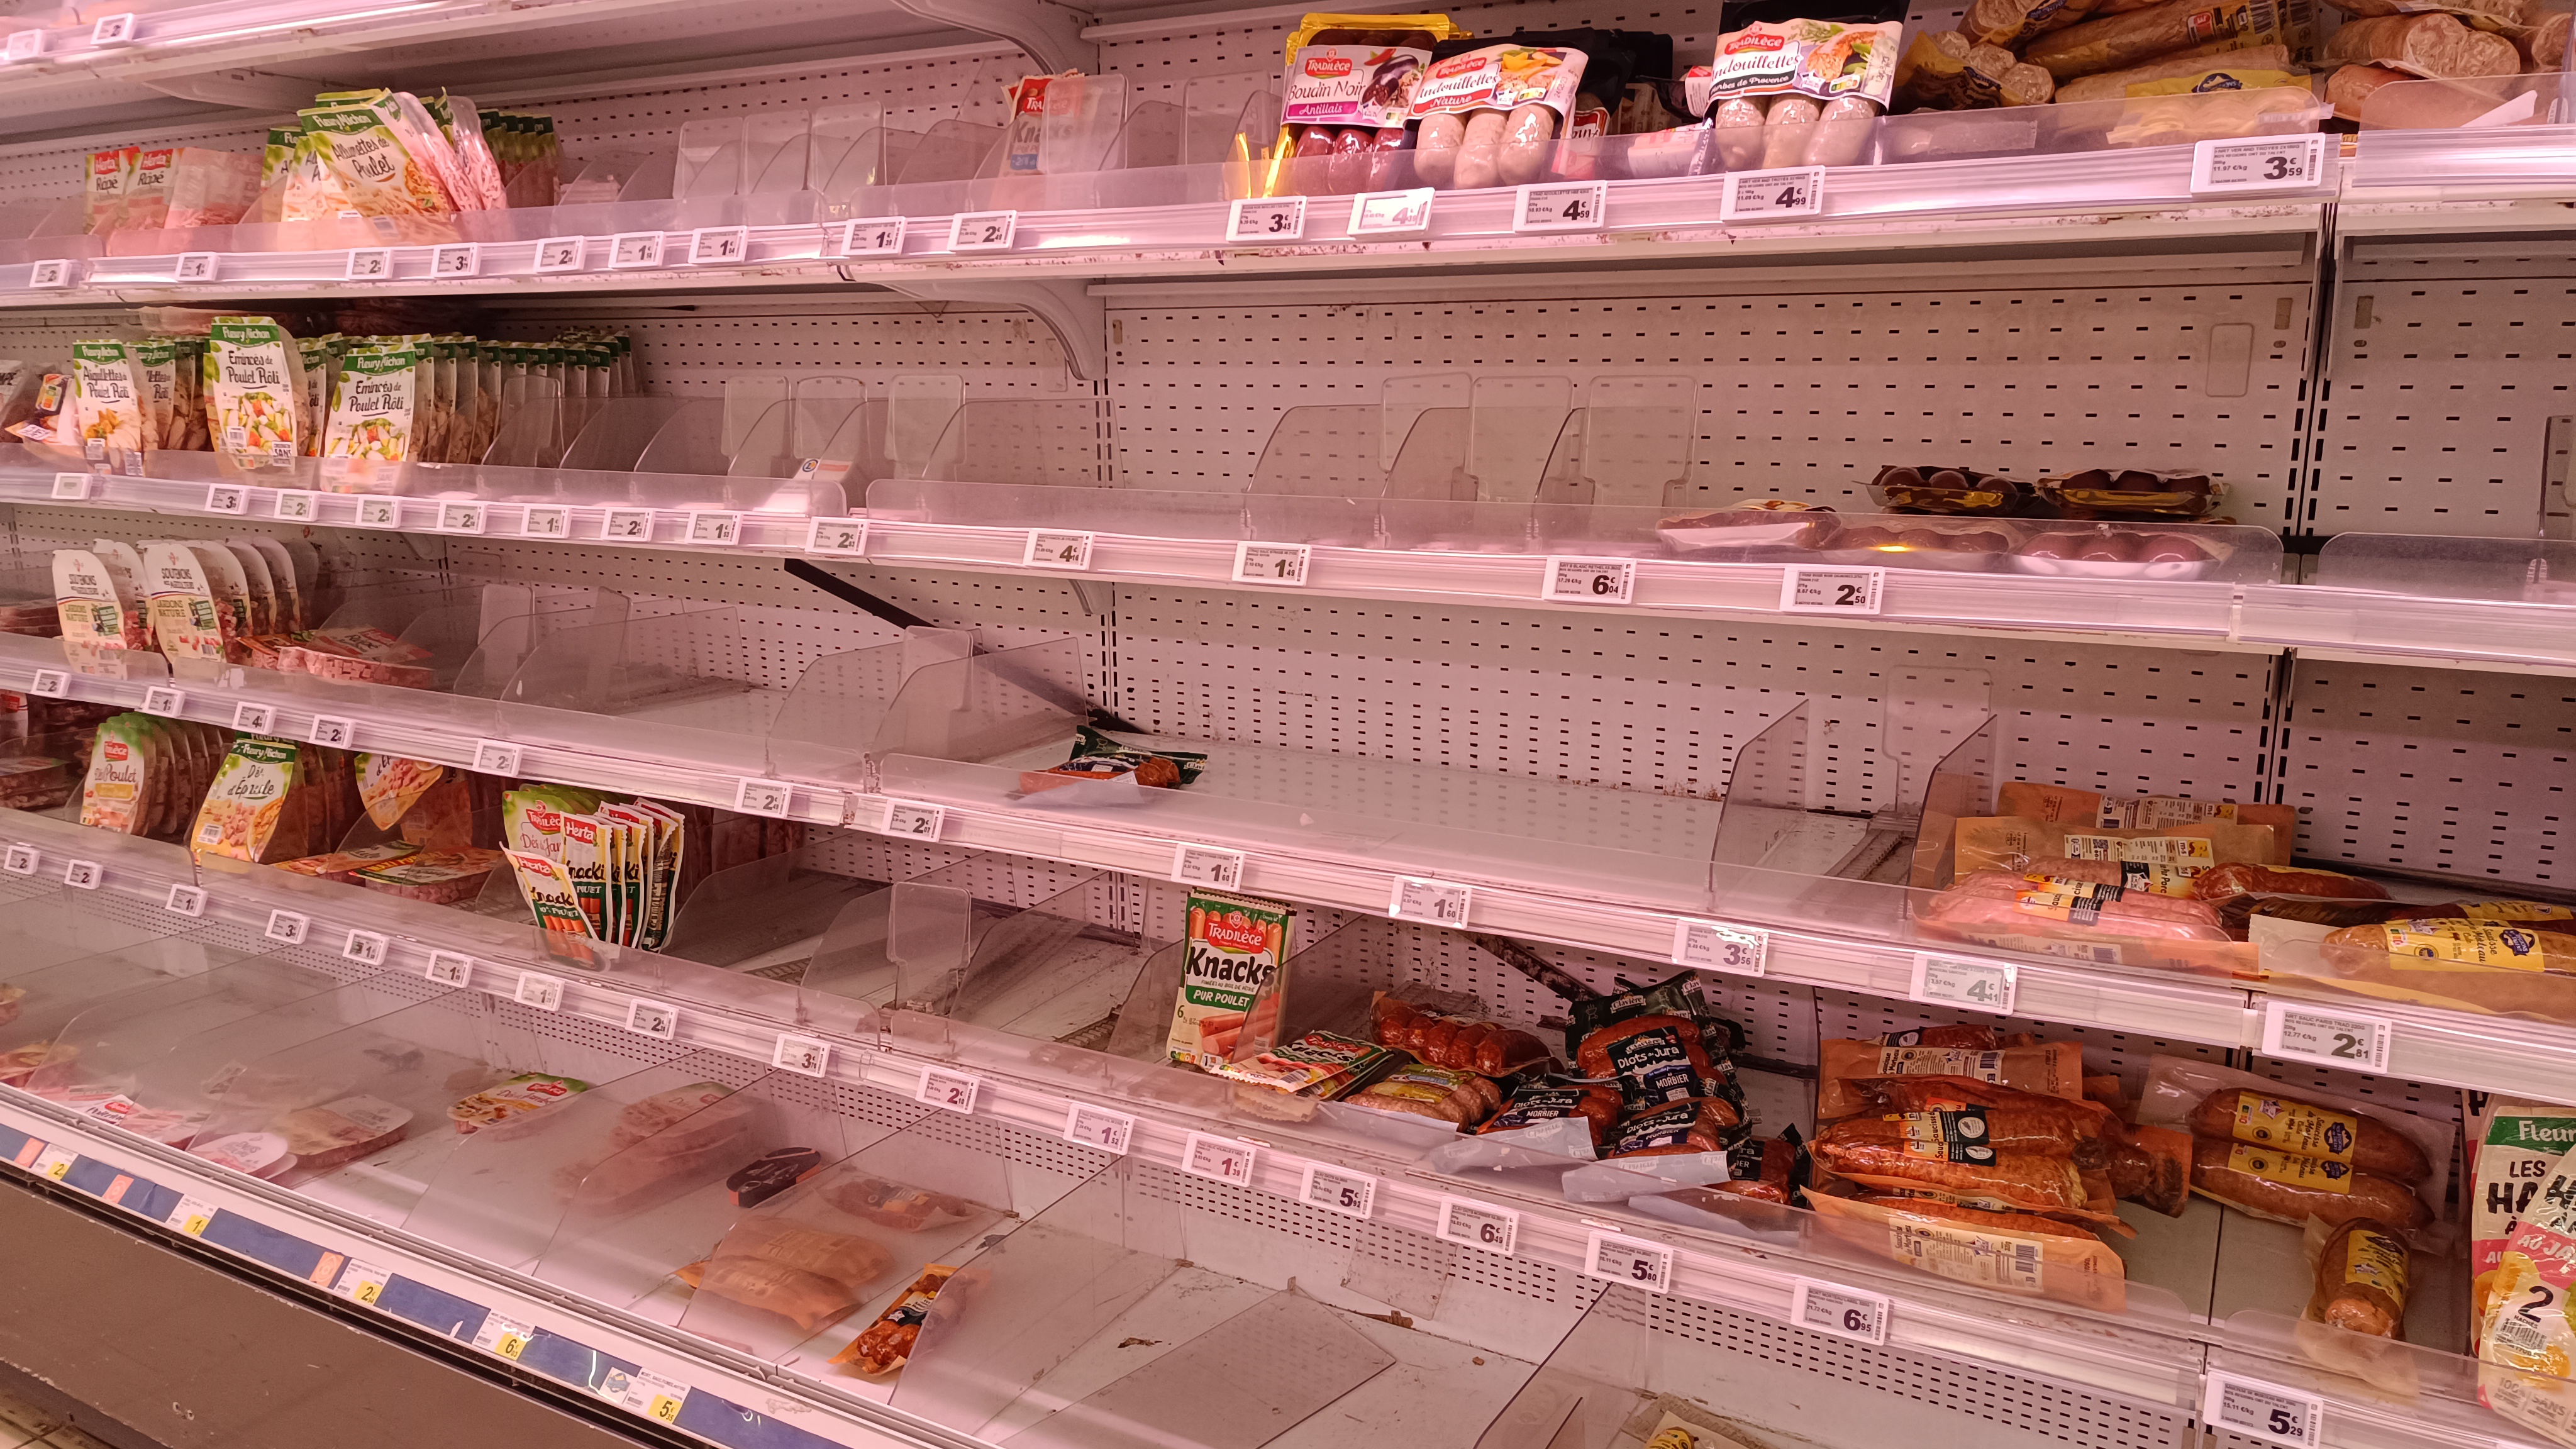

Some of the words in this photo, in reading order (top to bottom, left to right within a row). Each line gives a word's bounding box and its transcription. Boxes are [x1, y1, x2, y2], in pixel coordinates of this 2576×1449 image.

[1749, 75, 1789, 86] Provence
[1288, 82, 1331, 101] Boudin
[1334, 81, 1366, 97] Noir
[1430, 94, 1472, 108] Nature
[1299, 103, 1342, 115] Antillais
[352, 153, 396, 179] Poulet
[357, 357, 380, 370] Fleury
[226, 366, 255, 383] Poulet
[256, 367, 280, 384] Rôti
[394, 382, 401, 391] de
[349, 396, 379, 412] Poulet
[382, 394, 404, 410] Rôti
[104, 763, 136, 782] Poulet
[566, 822, 594, 841] Herta
[521, 833, 538, 848] Dés
[519, 857, 551, 874] Herta
[1186, 947, 1275, 987] Knacks
[1194, 990, 1212, 1001] PUR
[1215, 993, 1250, 1008] POULET
[1613, 996, 1644, 1010] Clavière
[1177, 1005, 1184, 1018] 6
[1655, 1046, 1679, 1057] Jura
[1655, 1074, 1689, 1089] MORBIER
[1548, 1097, 1572, 1105] Jura
[1663, 1113, 1689, 1124] Jura
[2509, 1160, 2546, 1178] LES
[2518, 1235, 2543, 1250] AU
[2518, 1285, 2554, 1323] 2
[2223, 1402, 2239, 1410] 15.11
[2241, 1407, 2254, 1415] €/kg
[2532, 1393, 2566, 1416] SANS
